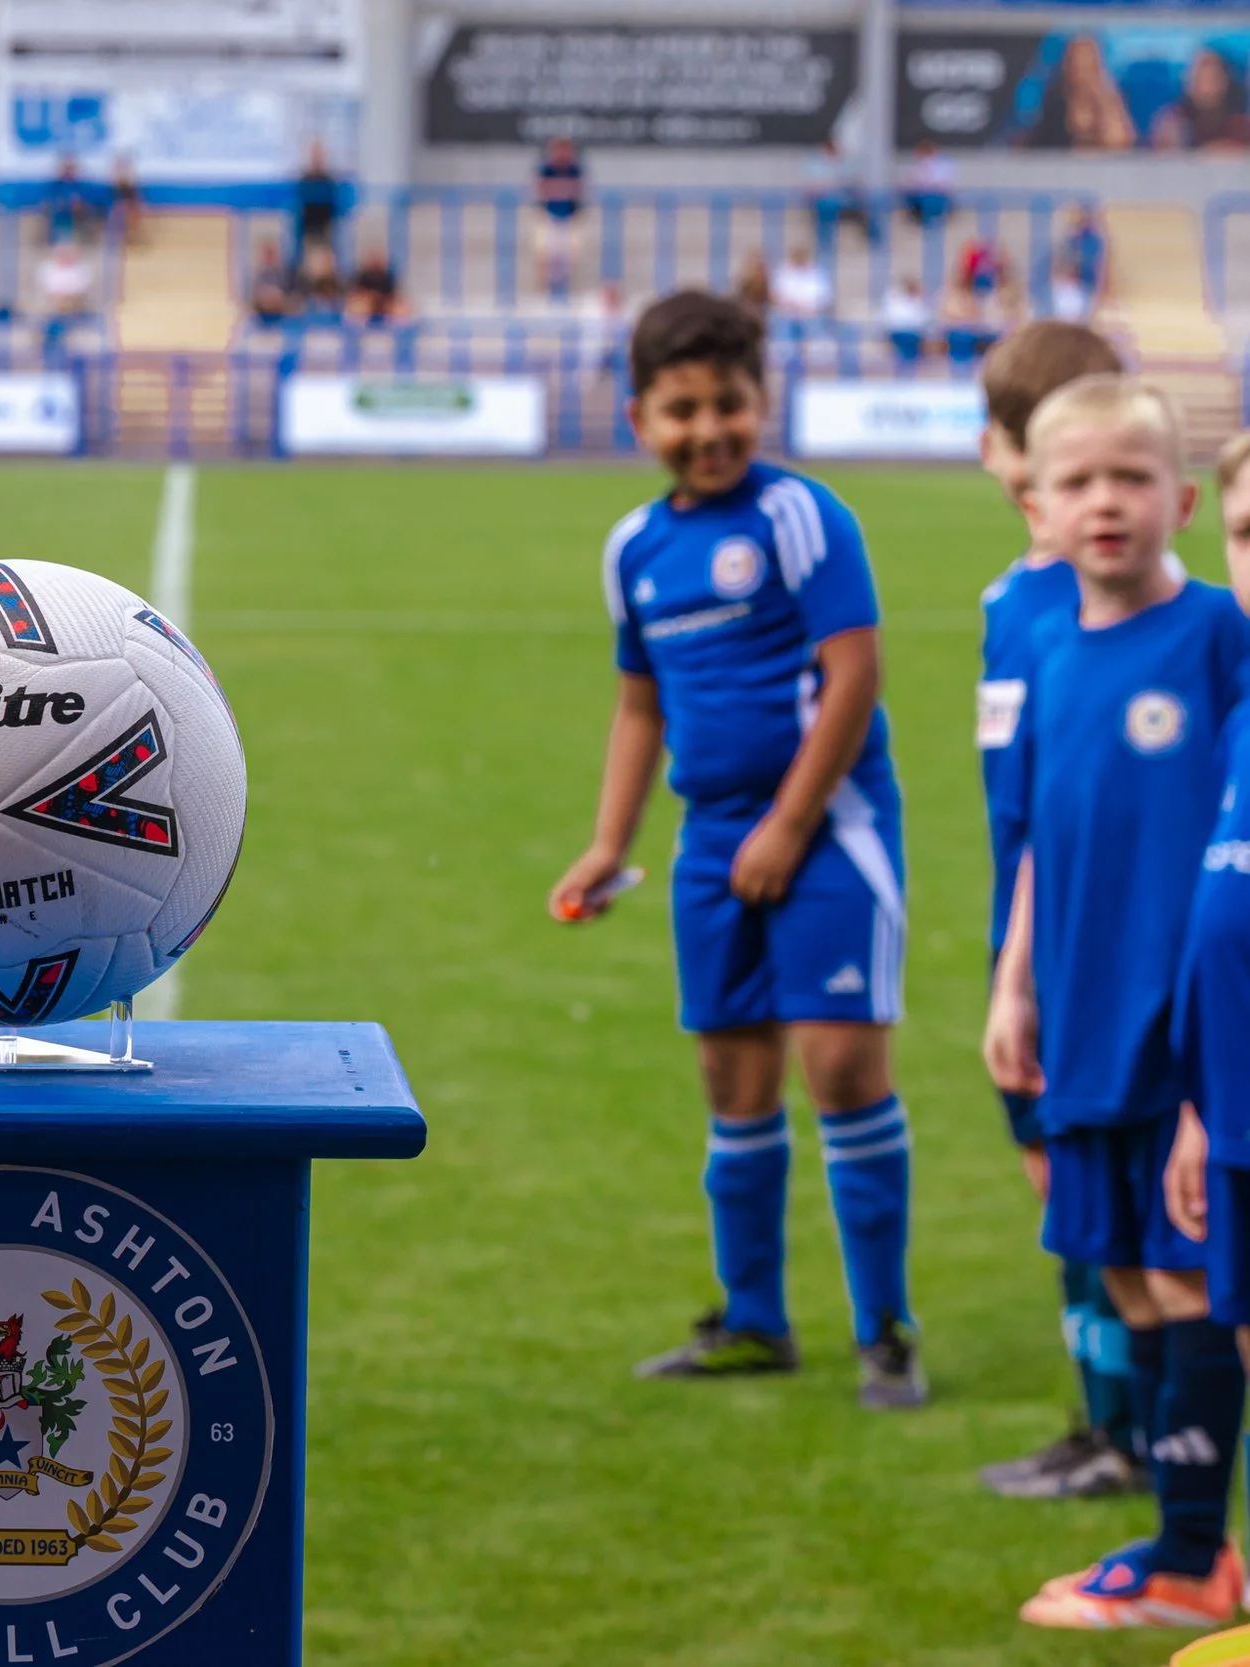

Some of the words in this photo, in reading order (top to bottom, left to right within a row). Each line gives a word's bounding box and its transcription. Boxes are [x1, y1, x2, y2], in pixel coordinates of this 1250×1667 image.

[30, 1190, 238, 1377] ASHTON
[210, 1422, 234, 1443] 63
[31, 1539, 68, 1557] 1963
[105, 1492, 228, 1631] CLUB
